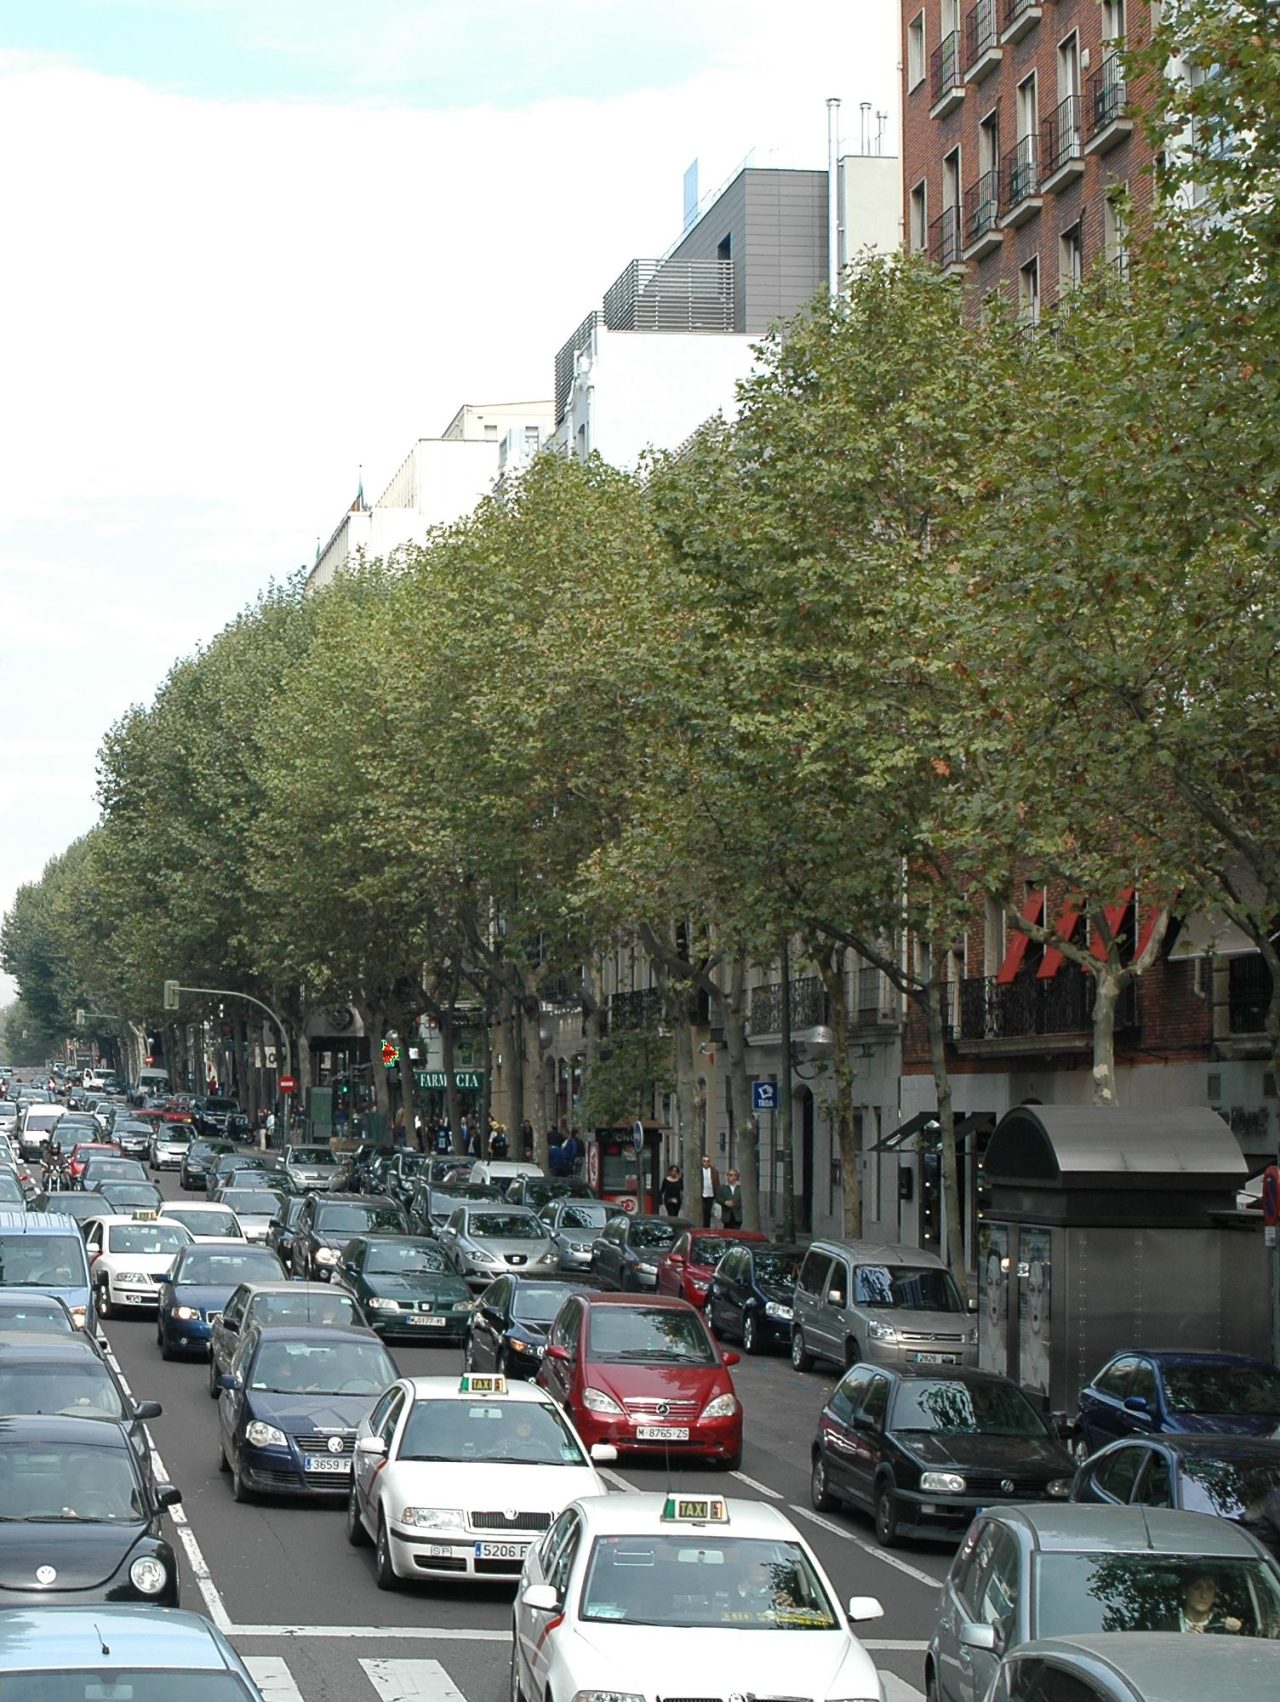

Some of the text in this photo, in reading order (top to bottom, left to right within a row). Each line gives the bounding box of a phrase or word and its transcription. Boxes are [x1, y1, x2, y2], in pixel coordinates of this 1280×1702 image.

[420, 1073, 479, 1087] FARMCIA
[473, 1379, 492, 1390] TAXI
[313, 1459, 340, 1470] 3659
[681, 1502, 707, 1517] TAXI
[433, 1545, 450, 1556] SP
[483, 1544, 516, 1557] 5206
